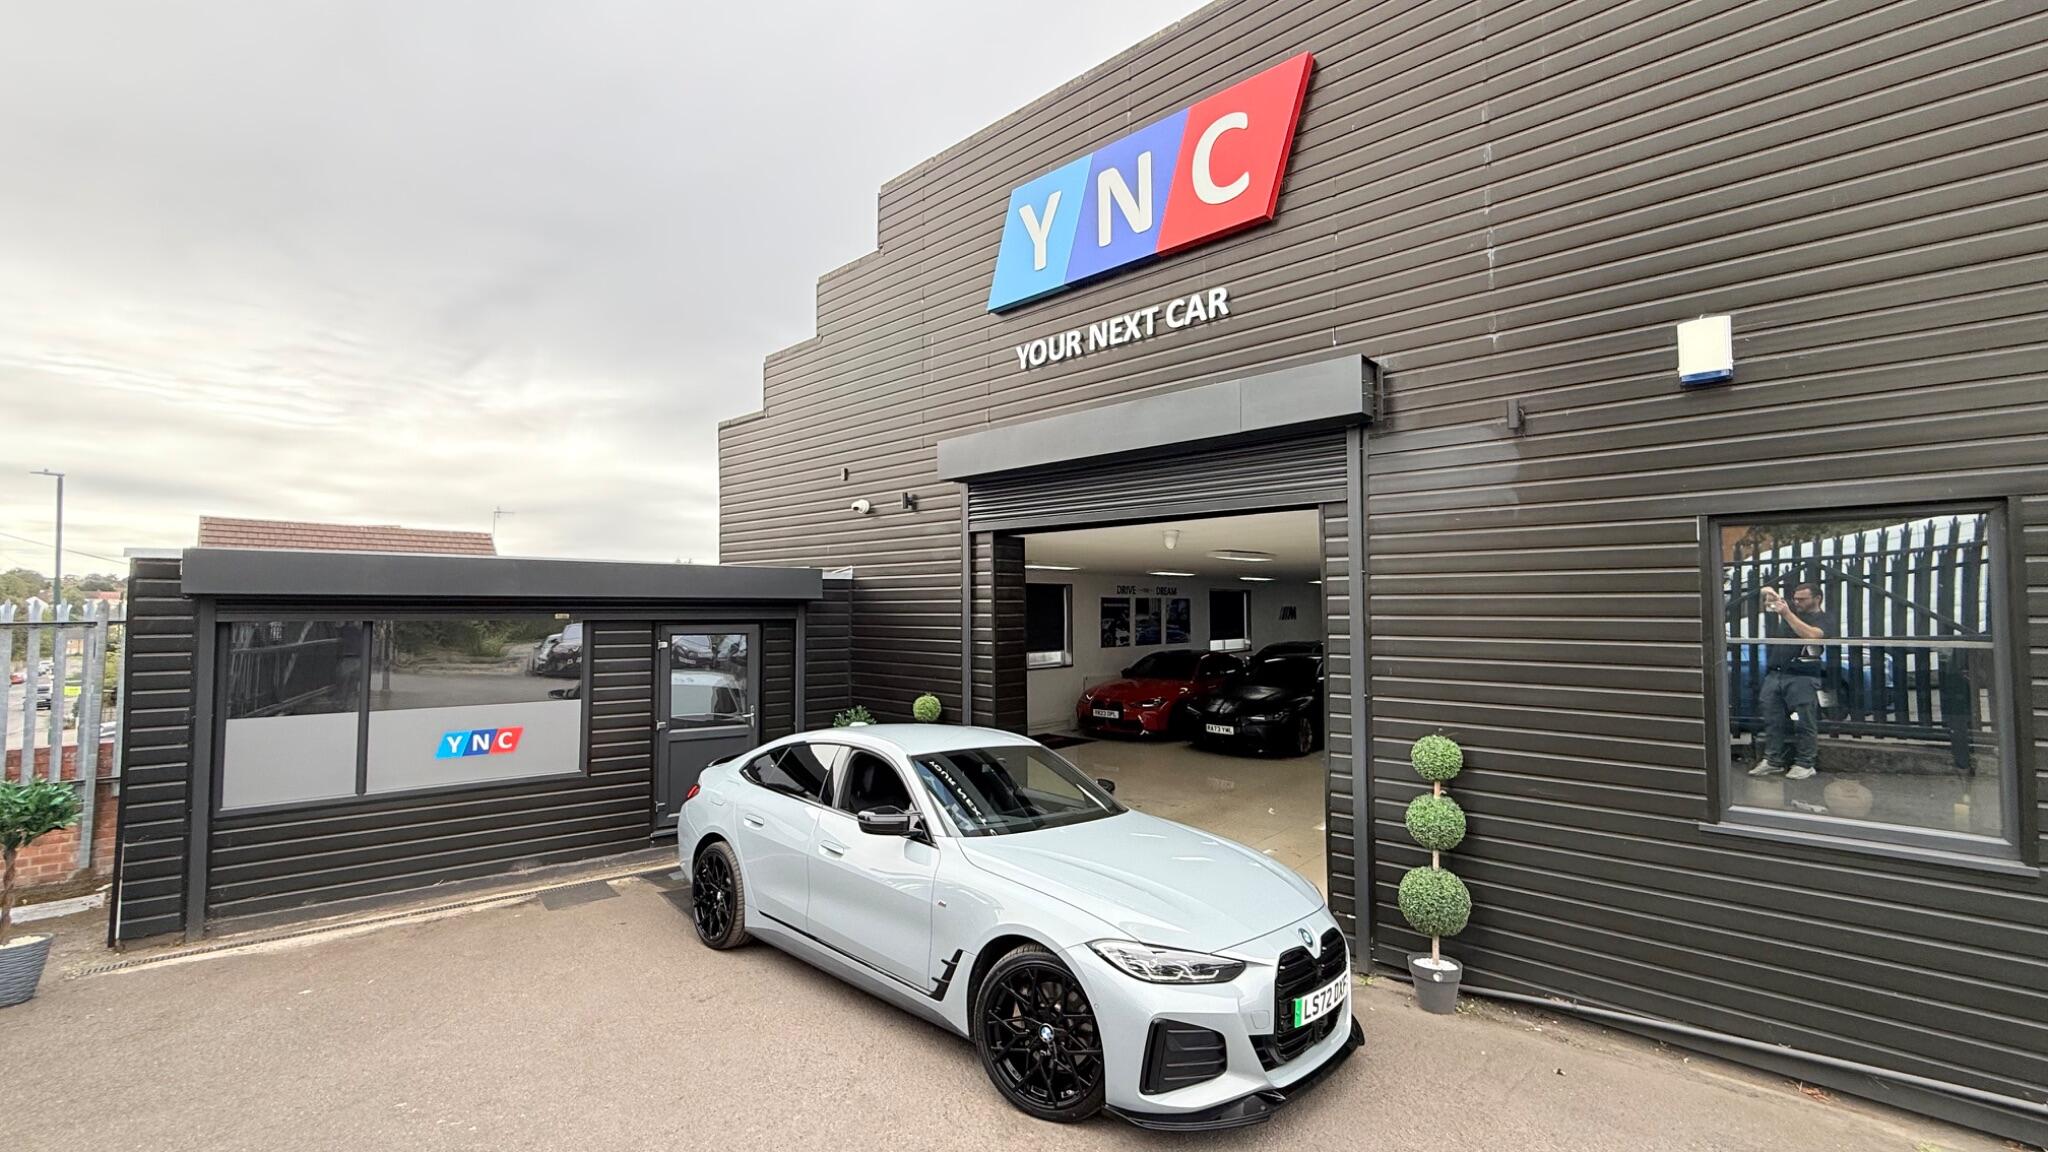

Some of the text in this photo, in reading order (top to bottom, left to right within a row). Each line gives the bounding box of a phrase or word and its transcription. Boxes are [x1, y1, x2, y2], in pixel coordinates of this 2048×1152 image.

[1018, 111, 1250, 272] YNC
[1016, 286, 1231, 370] YOUR NEXT CAR
[1116, 584, 1137, 595] DRIVE
[1156, 585, 1178, 596] DREAM
[446, 731, 513, 754] YNC
[1304, 987, 1333, 1020] LS72
